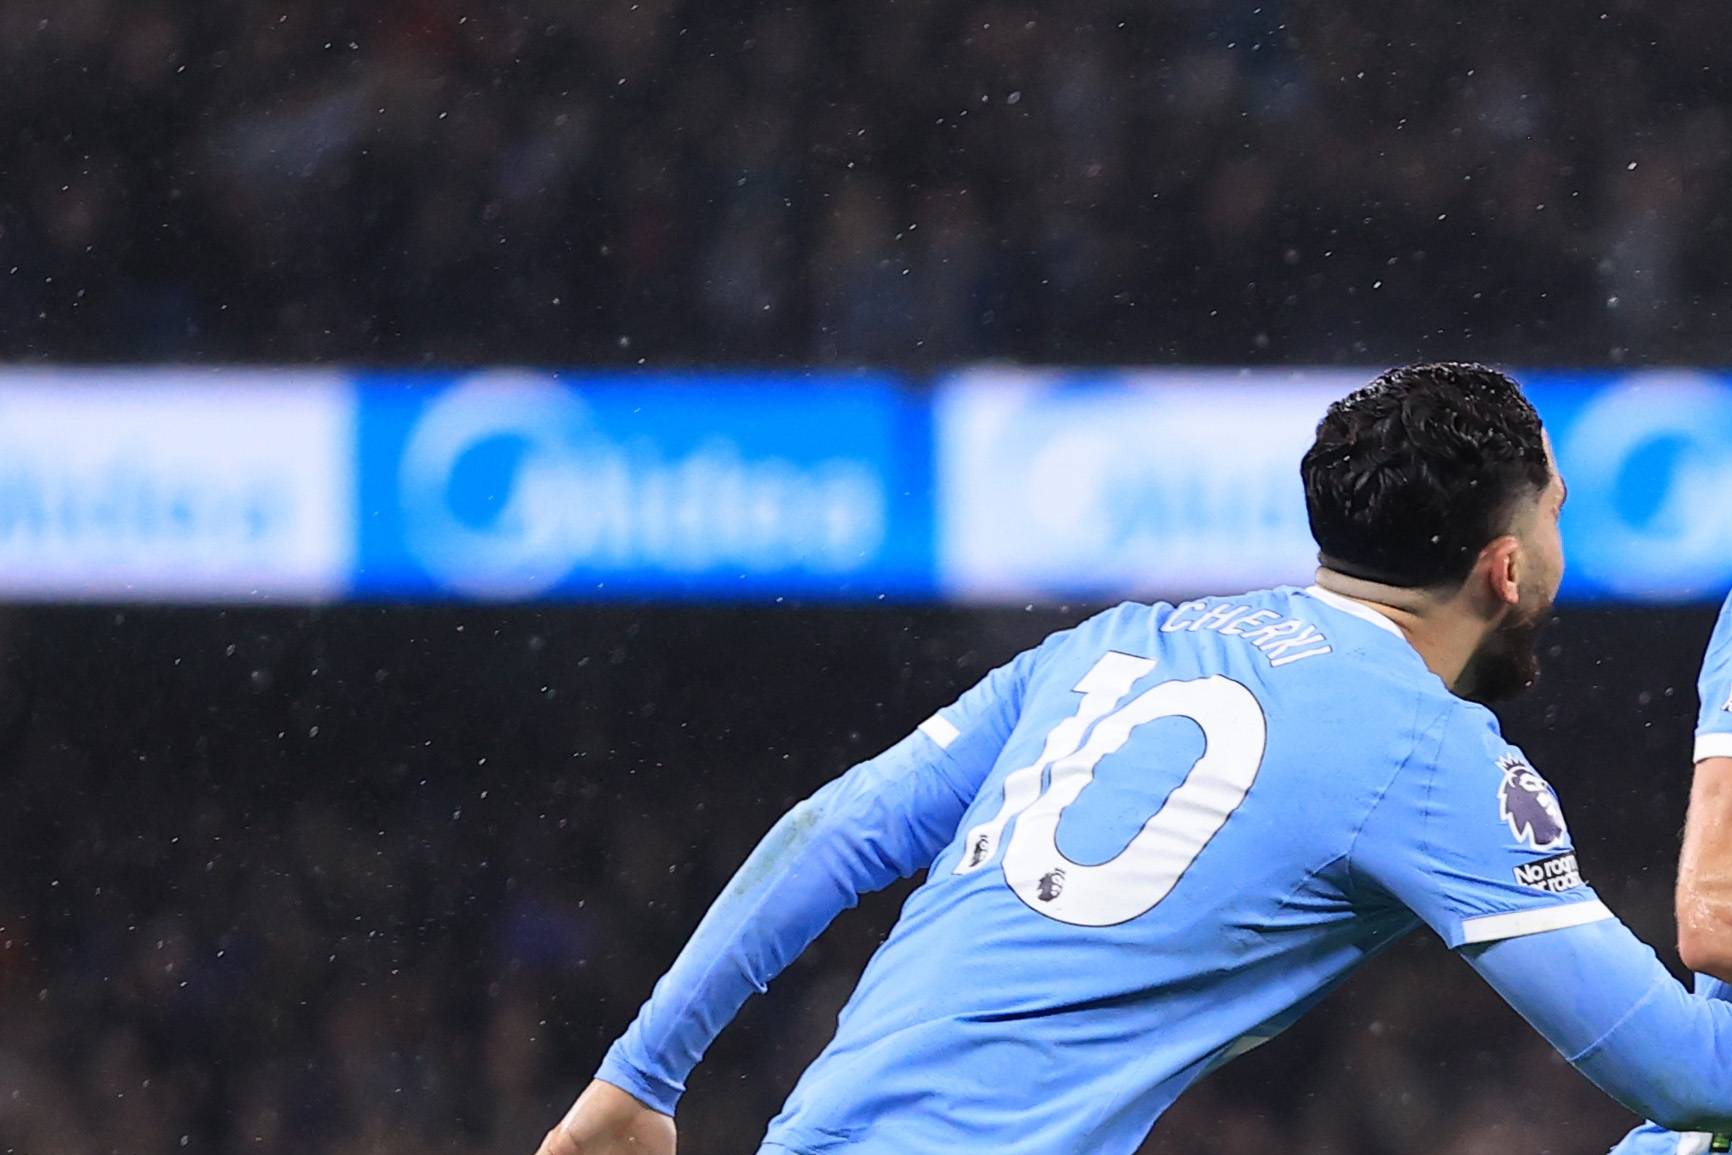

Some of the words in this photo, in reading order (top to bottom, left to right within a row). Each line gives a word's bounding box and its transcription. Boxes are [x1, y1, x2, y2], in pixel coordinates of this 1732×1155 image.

[1159, 600, 1333, 668] CHERKI
[952, 650, 1268, 928] 10
[1513, 863, 1544, 885] No
